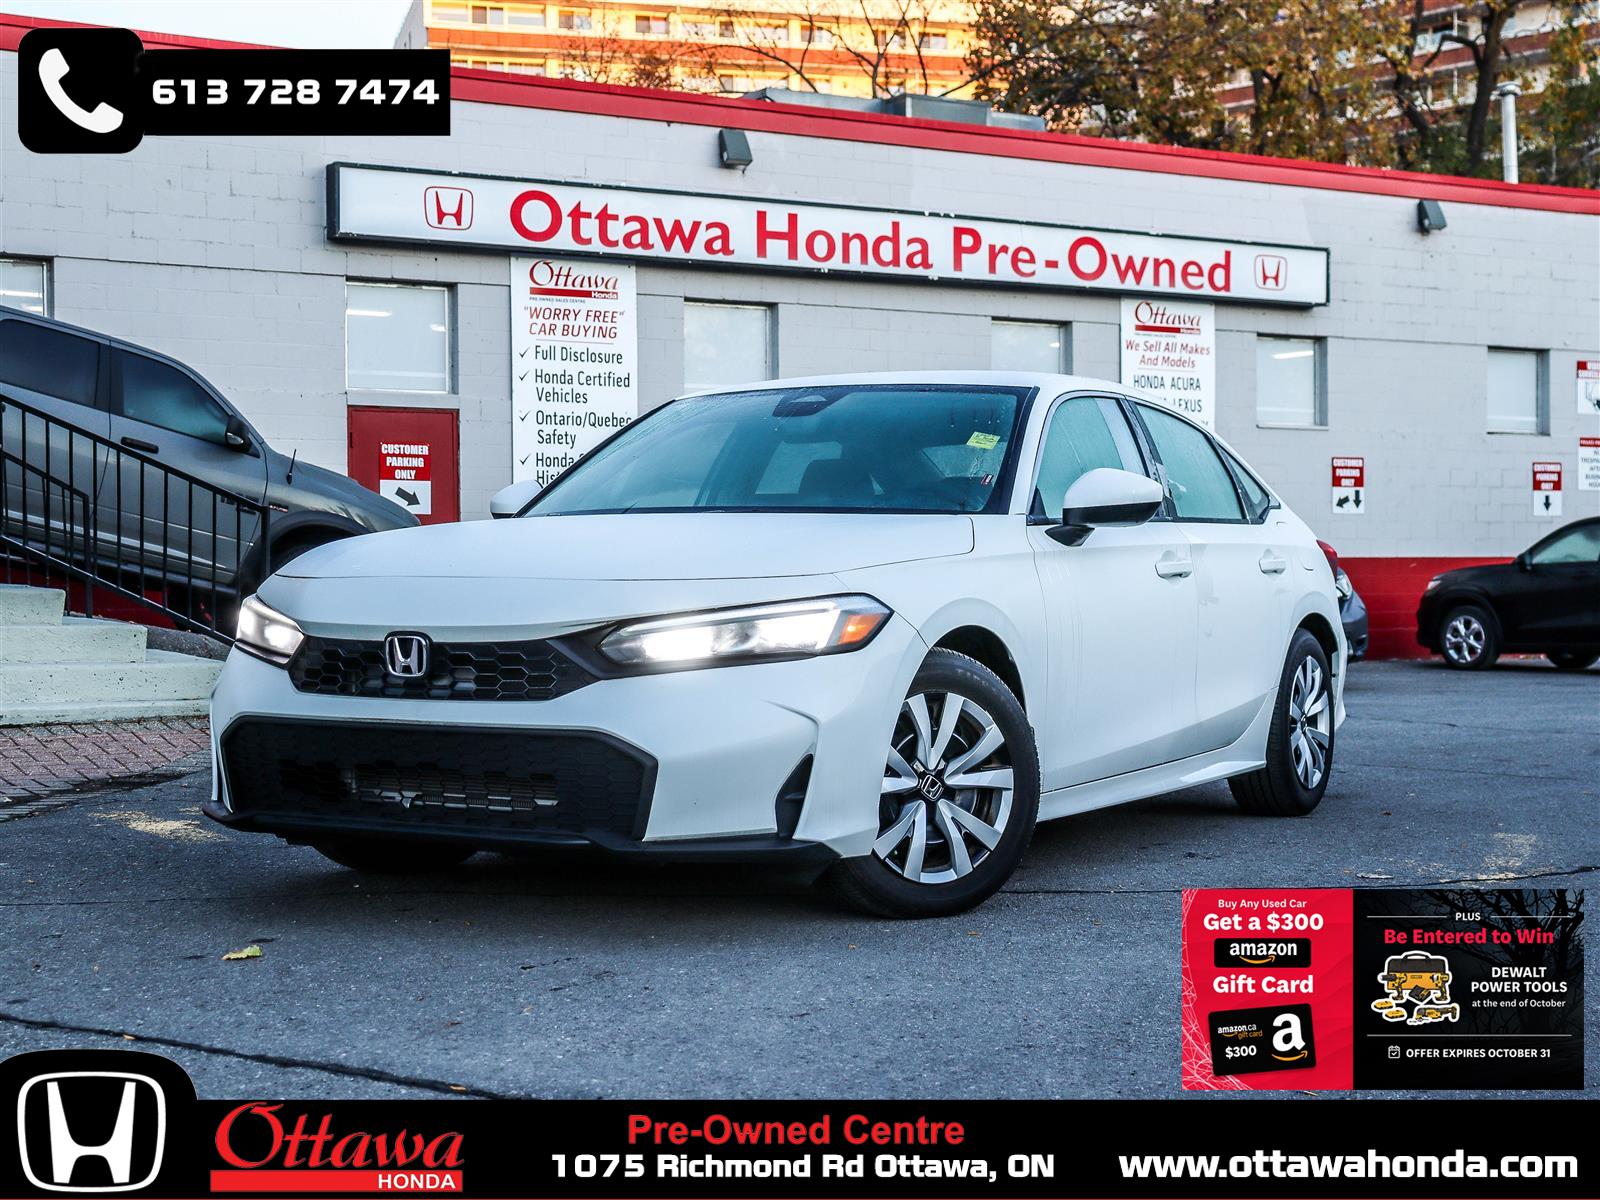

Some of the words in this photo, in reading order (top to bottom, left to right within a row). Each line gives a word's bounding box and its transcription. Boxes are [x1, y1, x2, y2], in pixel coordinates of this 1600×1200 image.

[510, 190, 733, 256] Ottawa
[756, 210, 932, 269] Honda
[953, 226, 1231, 292] Pre-Owned
[529, 260, 618, 290] Ottawa
[591, 291, 618, 299] Honda
[1135, 301, 1201, 326] Ottawa
[529, 323, 557, 336] CAR
[561, 325, 618, 339] BUYING
[535, 345, 556, 360] Full
[561, 347, 623, 364] Disclosure
[1126, 339, 1140, 351] We
[1143, 340, 1161, 352] Sell
[1163, 342, 1177, 353] All
[1180, 343, 1211, 355] Makes
[1139, 354, 1159, 366] And
[1161, 356, 1196, 368] Models
[535, 368, 574, 385] Honda
[577, 371, 630, 388] Certified
[1133, 375, 1165, 389] HONDA
[1170, 377, 1201, 391] ACURA
[536, 387, 588, 404] Vehicles
[537, 429, 576, 449] Safety
[381, 443, 429, 455] CUSTOMER
[386, 456, 424, 468] PARKING
[395, 469, 416, 480] ONLY
